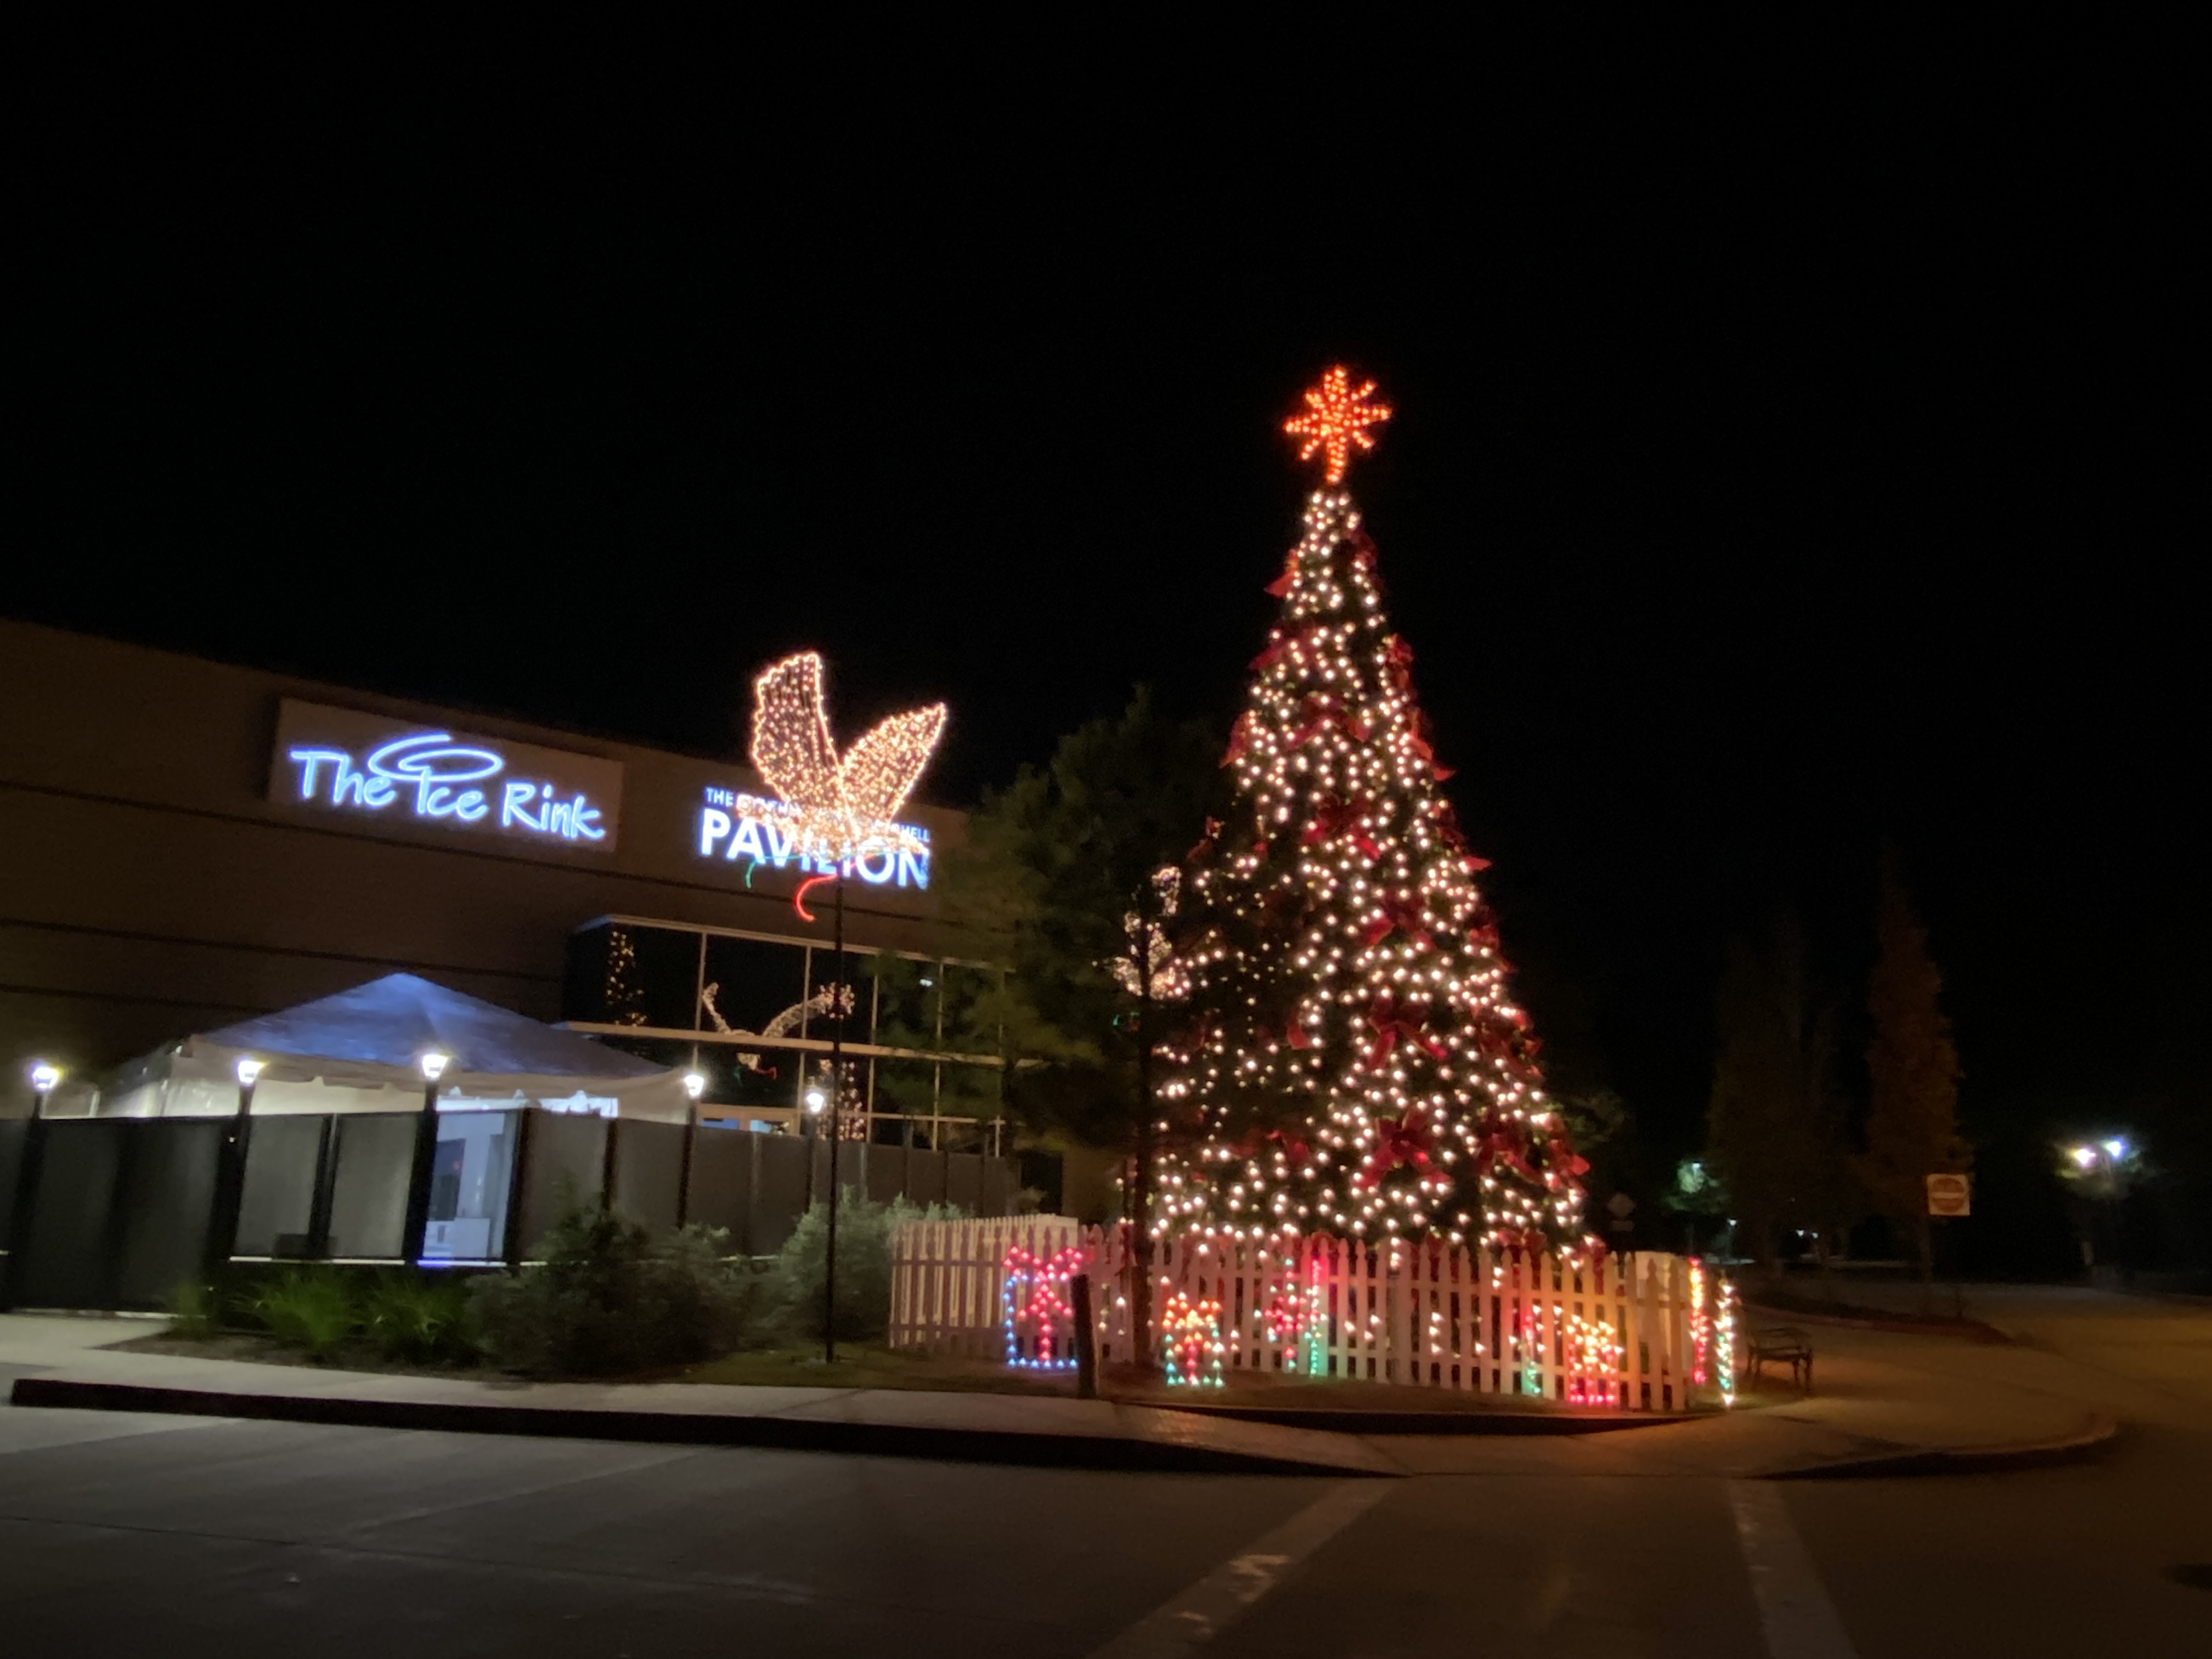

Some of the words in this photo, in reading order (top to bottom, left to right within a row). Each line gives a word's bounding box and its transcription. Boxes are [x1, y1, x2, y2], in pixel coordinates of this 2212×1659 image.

[290, 748, 397, 806] The
[500, 781, 606, 840] Rink
[705, 787, 734, 808] THE
[700, 808, 930, 889] PAVILION
